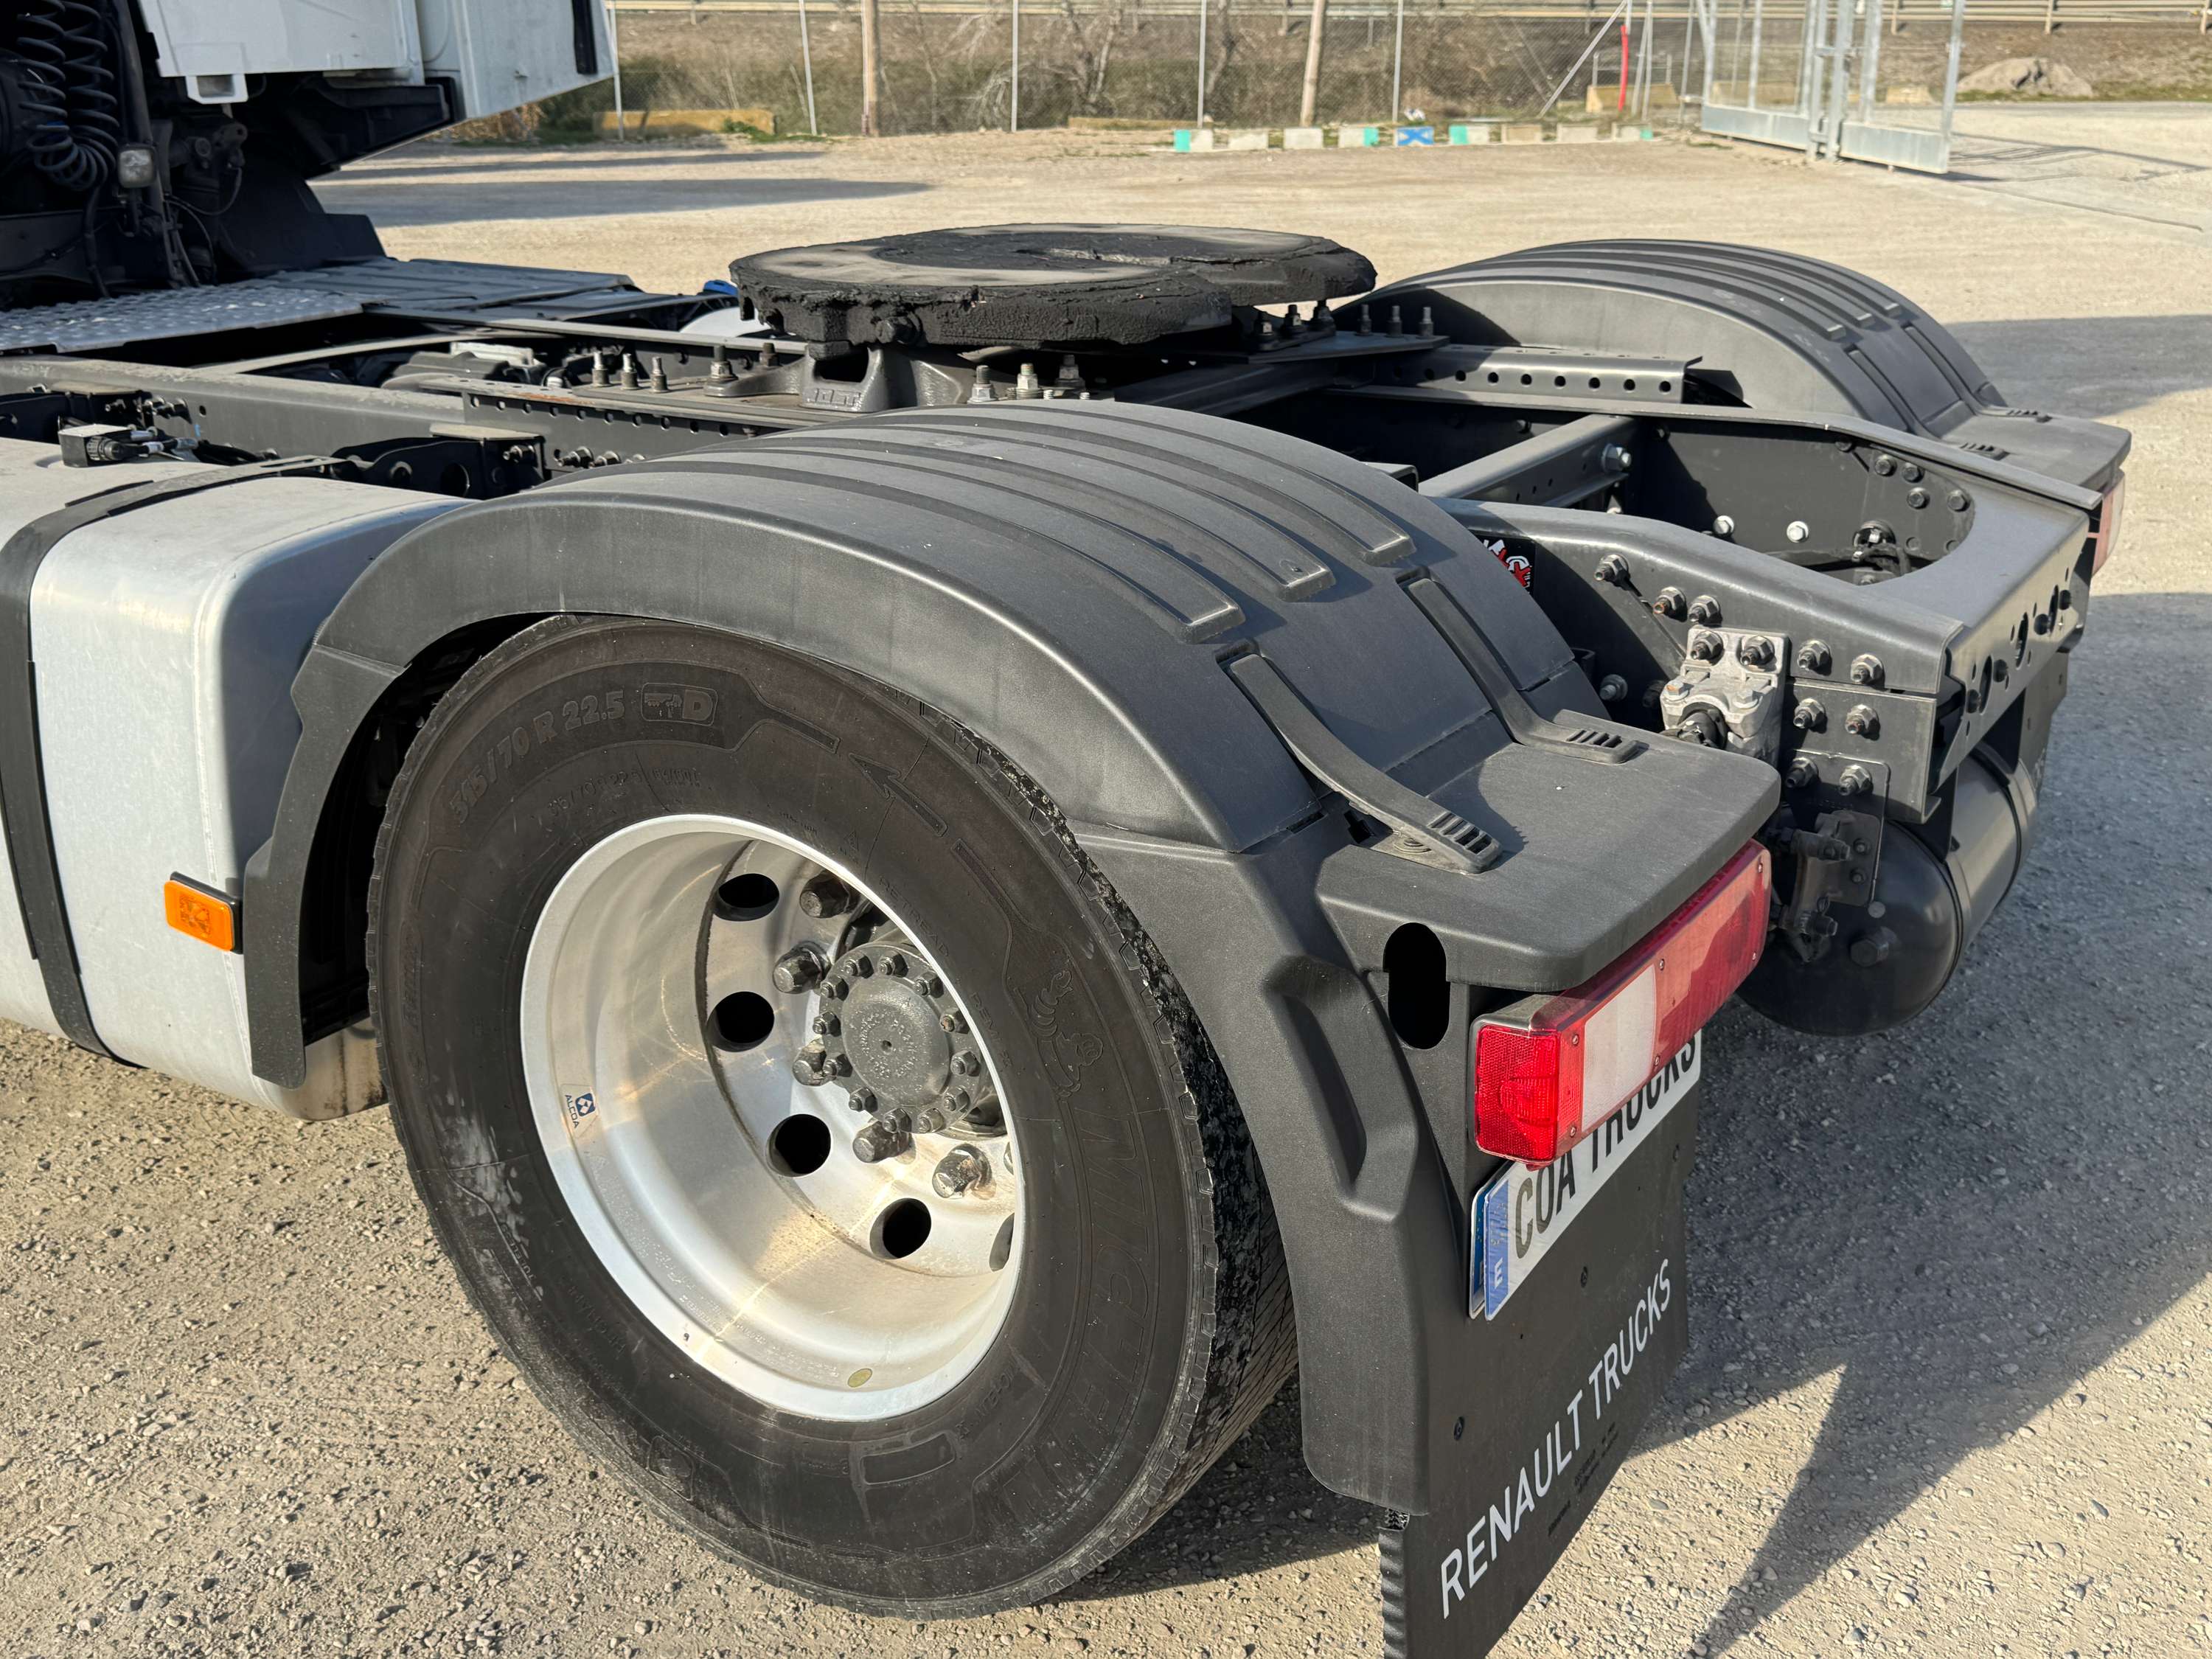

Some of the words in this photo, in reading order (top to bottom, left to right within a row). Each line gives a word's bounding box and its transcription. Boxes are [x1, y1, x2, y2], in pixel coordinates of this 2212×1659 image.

[448, 726, 531, 824] 315/70
[532, 711, 557, 745] R
[562, 690, 626, 731] 22.5
[681, 688, 714, 722] D
[565, 1094, 580, 1129] ALCOA
[1515, 1151, 1576, 1259] COA
[1494, 1257, 1503, 1290] E
[1440, 1389, 1584, 1619] RENAULT
[1588, 1259, 1672, 1420] TRUCKS
